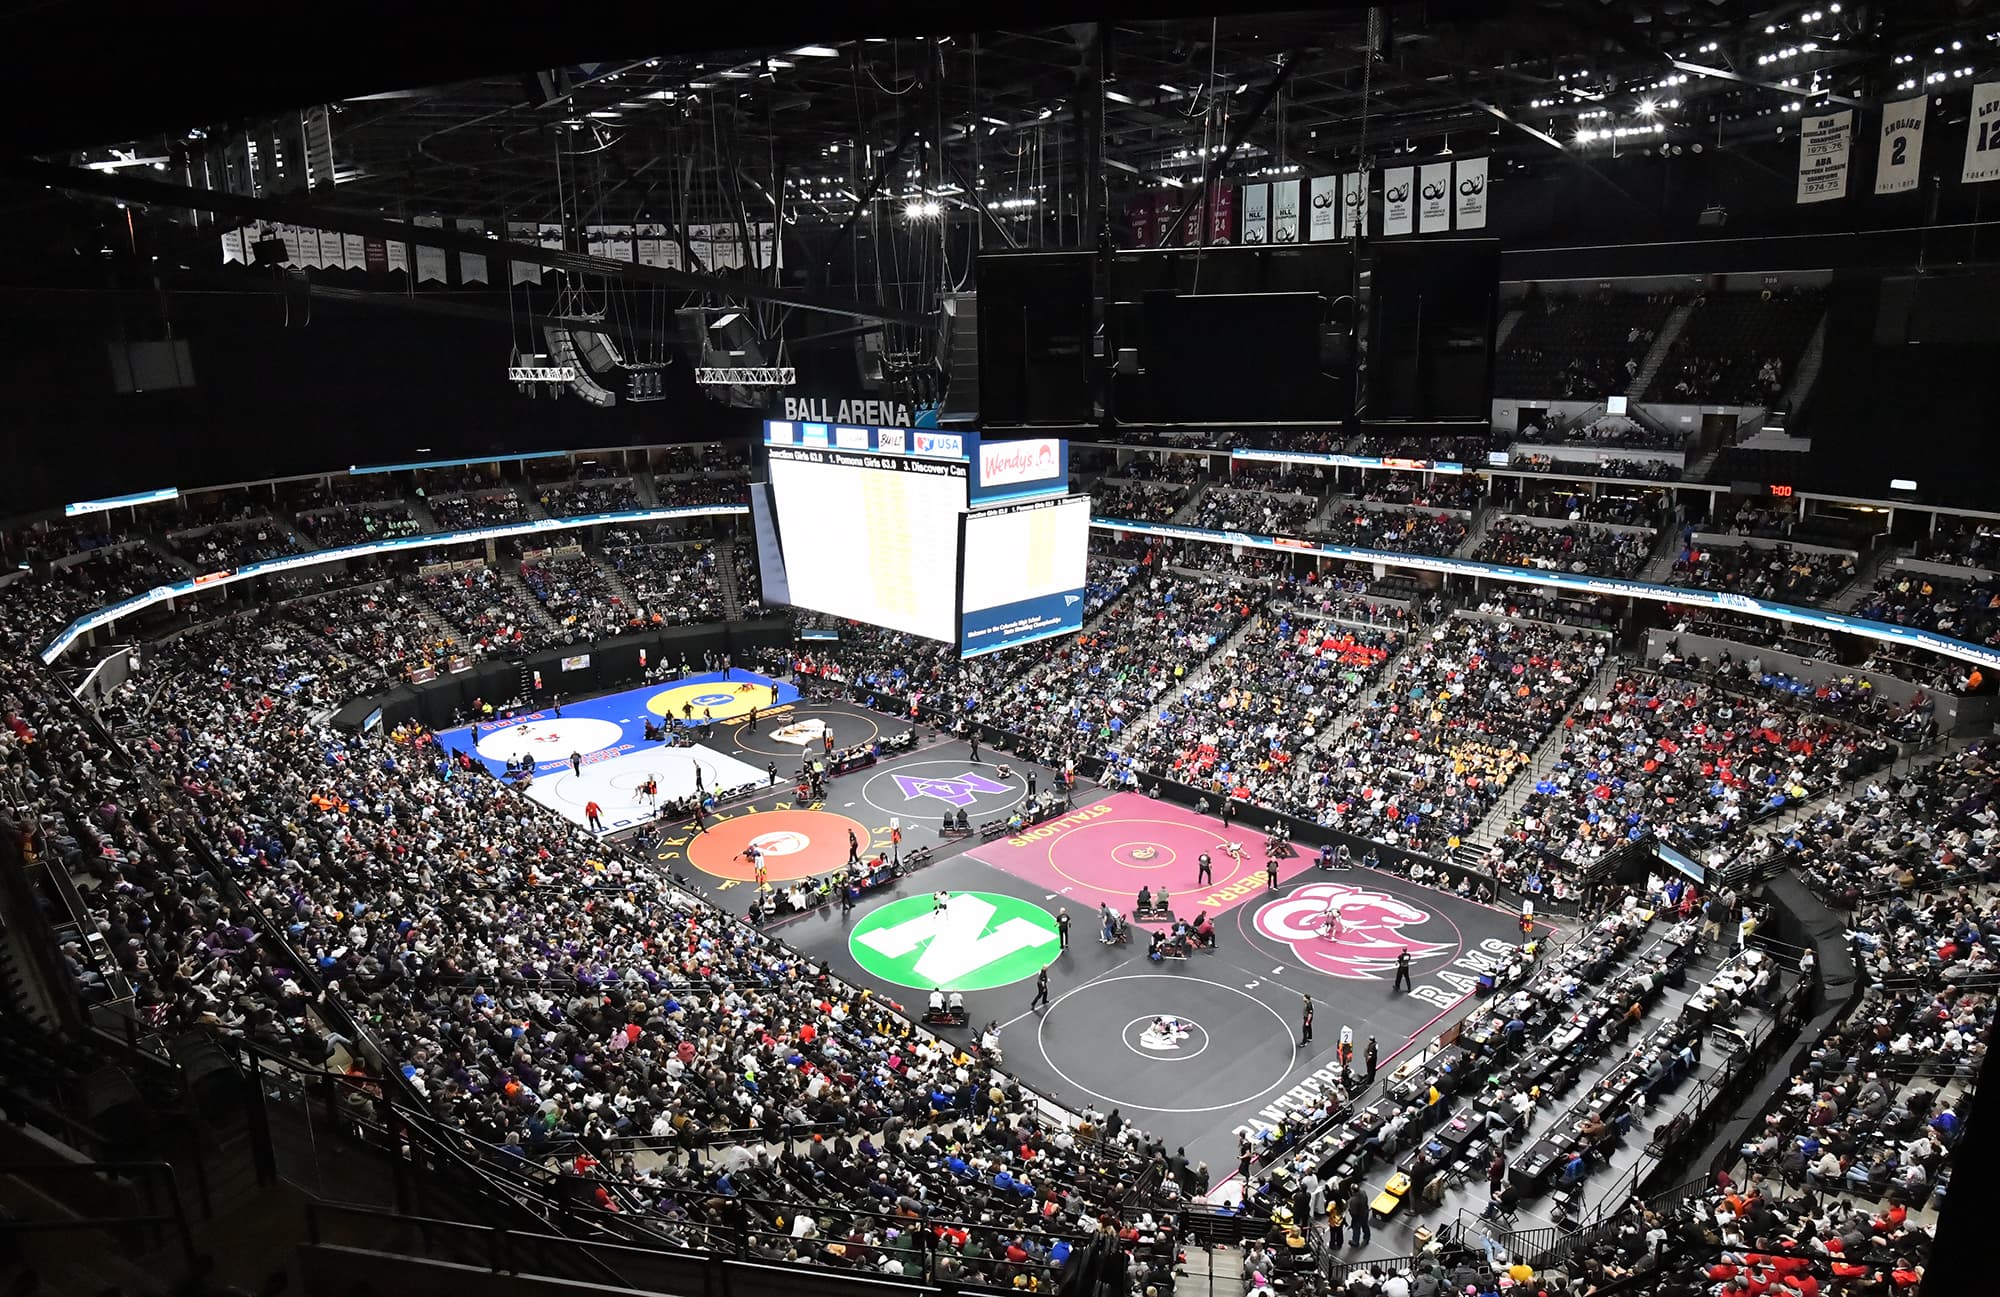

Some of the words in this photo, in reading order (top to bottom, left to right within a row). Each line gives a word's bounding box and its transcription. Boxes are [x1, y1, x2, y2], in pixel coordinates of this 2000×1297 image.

[1979, 100, 2000, 117] LEV
[1817, 119, 1834, 129] ABA
[1885, 118, 1922, 137] ENGLISH
[1891, 136, 1907, 166] 2
[1815, 157, 1832, 167] ABA
[1215, 218, 1226, 232] 24
[785, 397, 832, 423] BALL
[837, 399, 911, 427] ARENA
[938, 438, 959, 450] USA
[794, 451, 809, 462] Girls
[836, 455, 864, 467] Pomona
[864, 457, 881, 468] Girls
[903, 461, 910, 471] 3.
[911, 462, 949, 476] Discovery
[950, 465, 967, 477] Can
[1770, 485, 1792, 497] 7:00
[657, 801, 827, 861] SKYLINE
[1007, 804, 1113, 847] STALLIONS
[1196, 870, 1270, 908] SIERRA
[1408, 938, 1517, 1010] RAMS
[1245, 980, 1260, 990] 2
[1344, 1033, 1349, 1043] 2
[1231, 1060, 1344, 1145] PANTHERS
